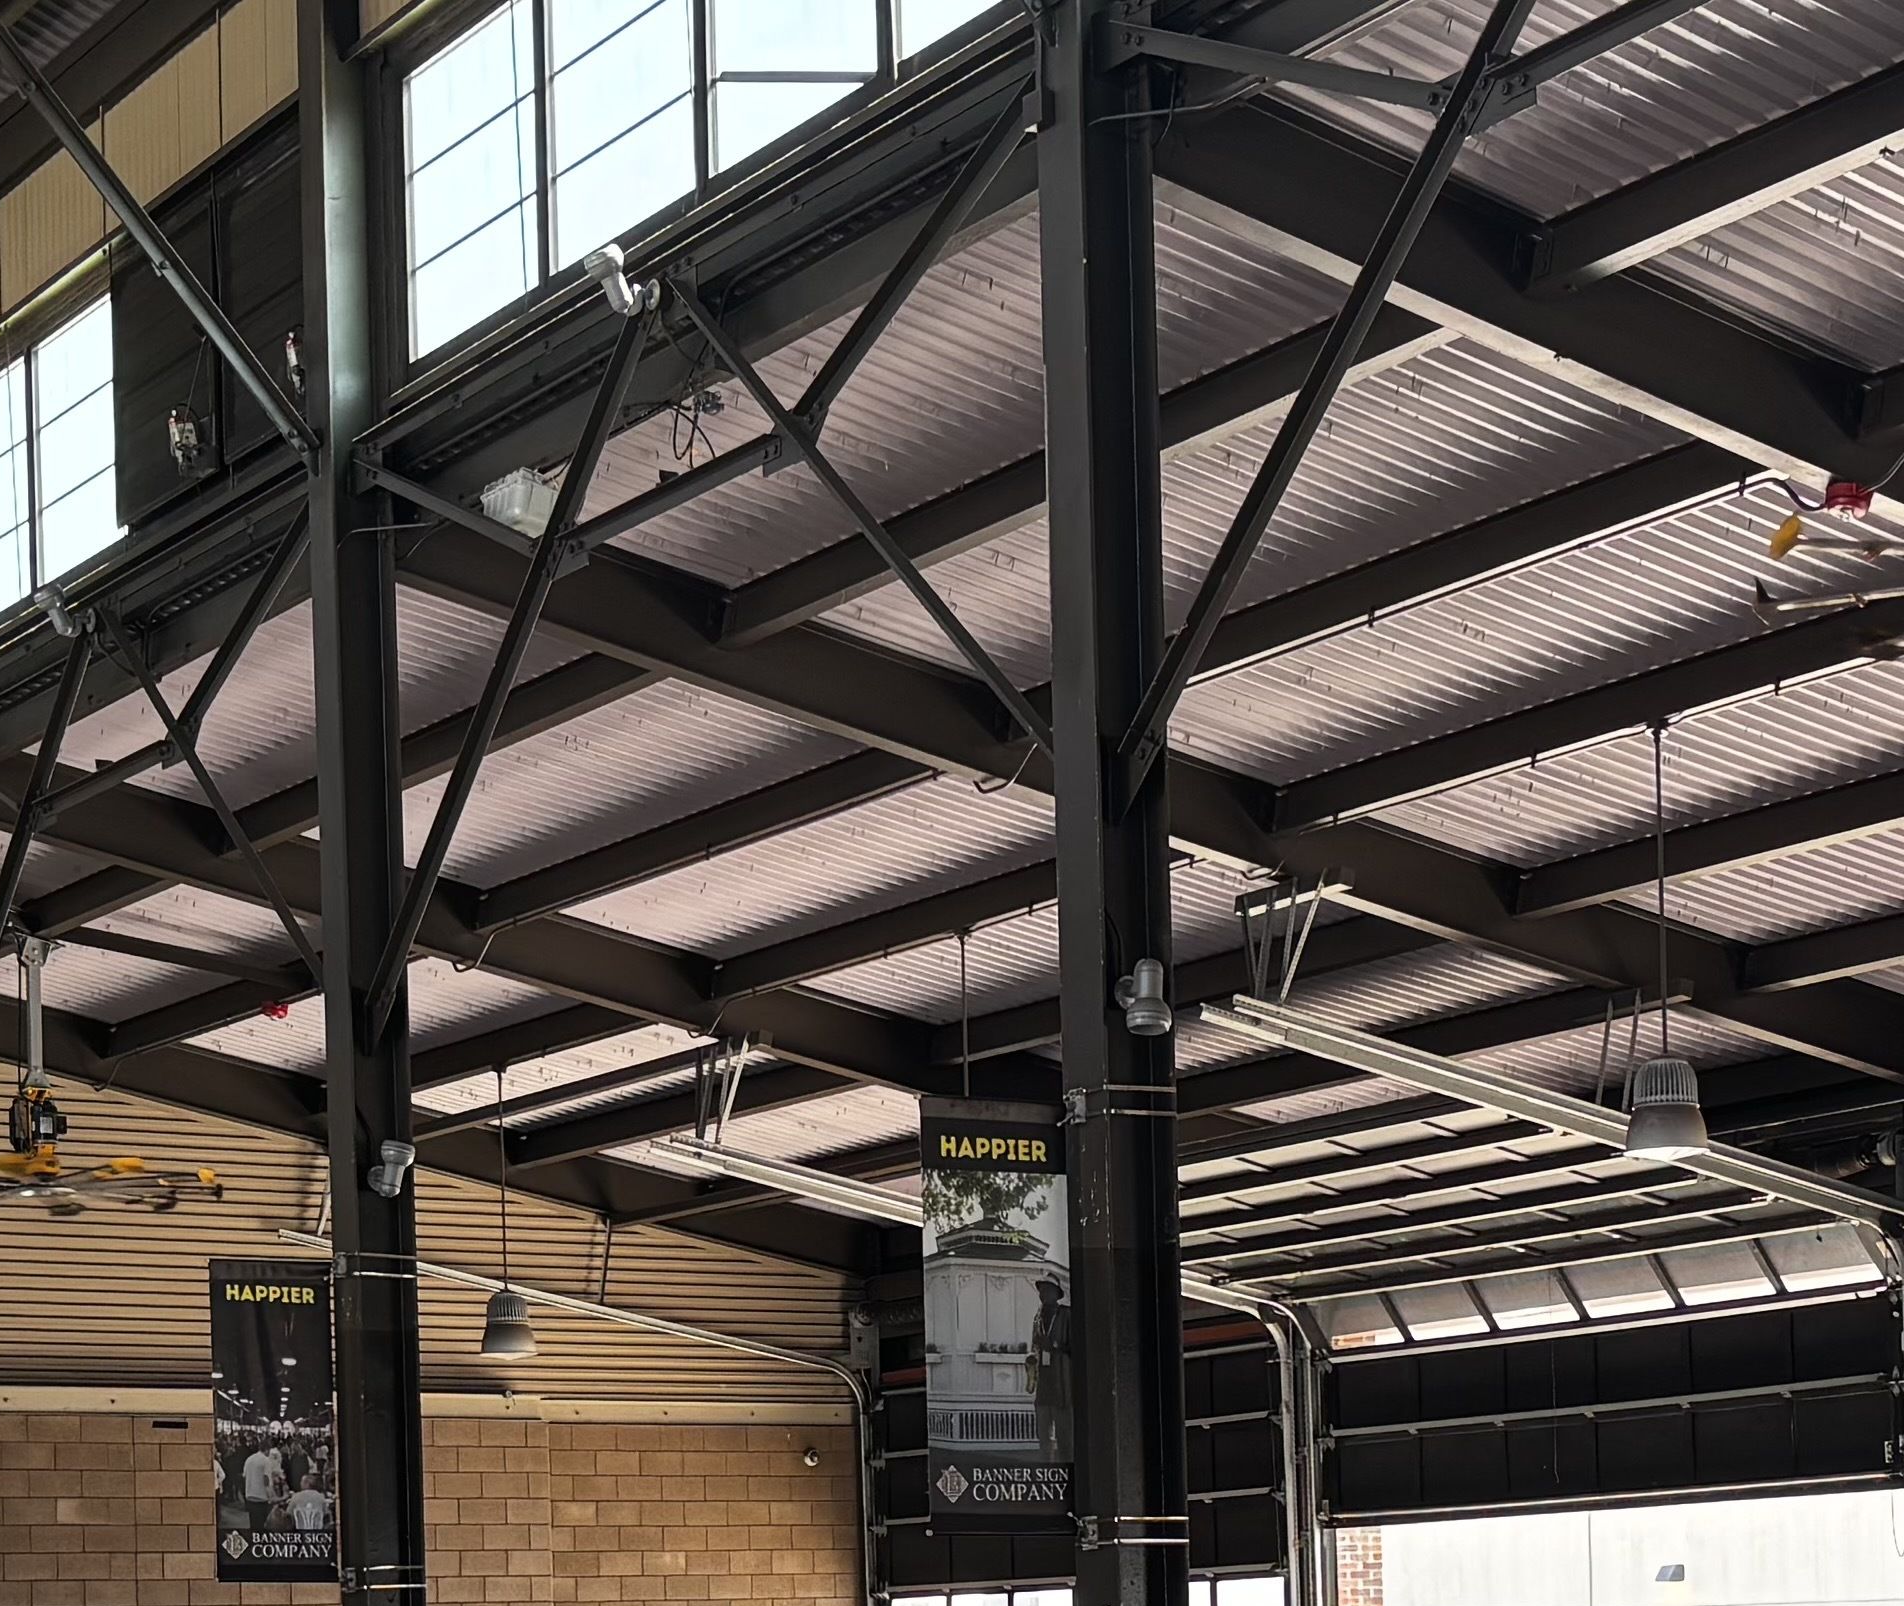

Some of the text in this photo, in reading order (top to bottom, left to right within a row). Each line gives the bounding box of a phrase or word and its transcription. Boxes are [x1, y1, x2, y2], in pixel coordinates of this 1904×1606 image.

[940, 1135, 1047, 1162] HAPPIER
[225, 1284, 315, 1304] HAPPIER
[972, 1467, 1069, 1482] BANNER SIGN
[973, 1483, 1068, 1502] COMPANY
[252, 1531, 333, 1544] BANNER SIGN
[252, 1544, 332, 1559] COMPANY
